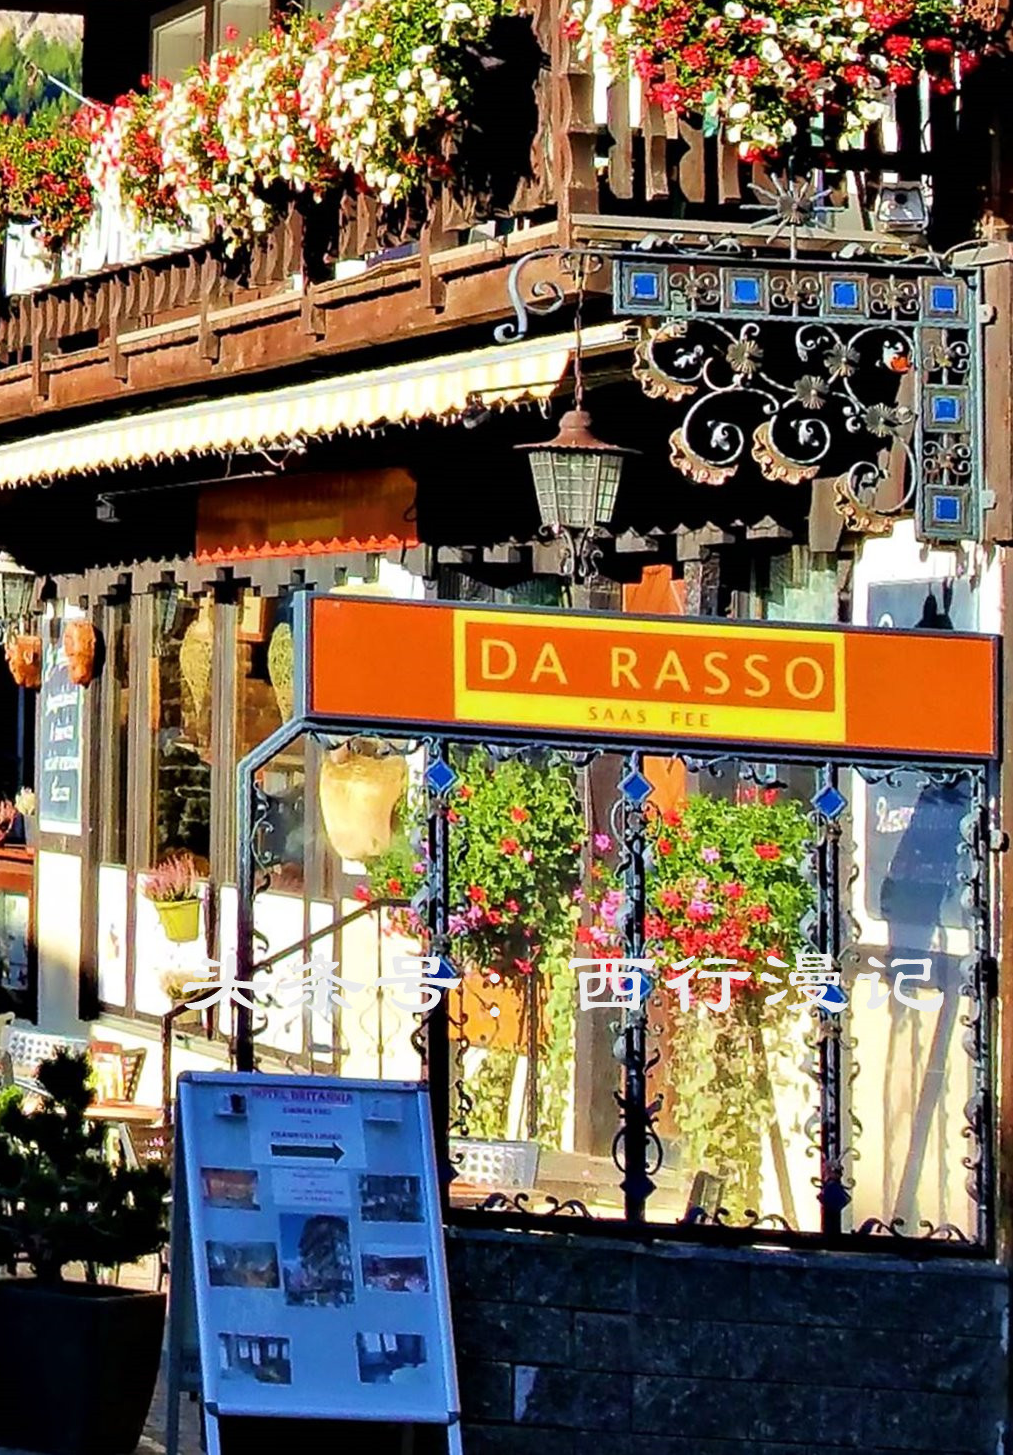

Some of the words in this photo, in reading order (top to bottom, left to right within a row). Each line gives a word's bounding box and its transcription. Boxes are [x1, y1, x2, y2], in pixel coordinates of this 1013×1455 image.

[481, 639, 569, 685] DA
[610, 647, 825, 701] RASSO
[588, 706, 647, 725] SAAS
[671, 712, 711, 728] FEE
